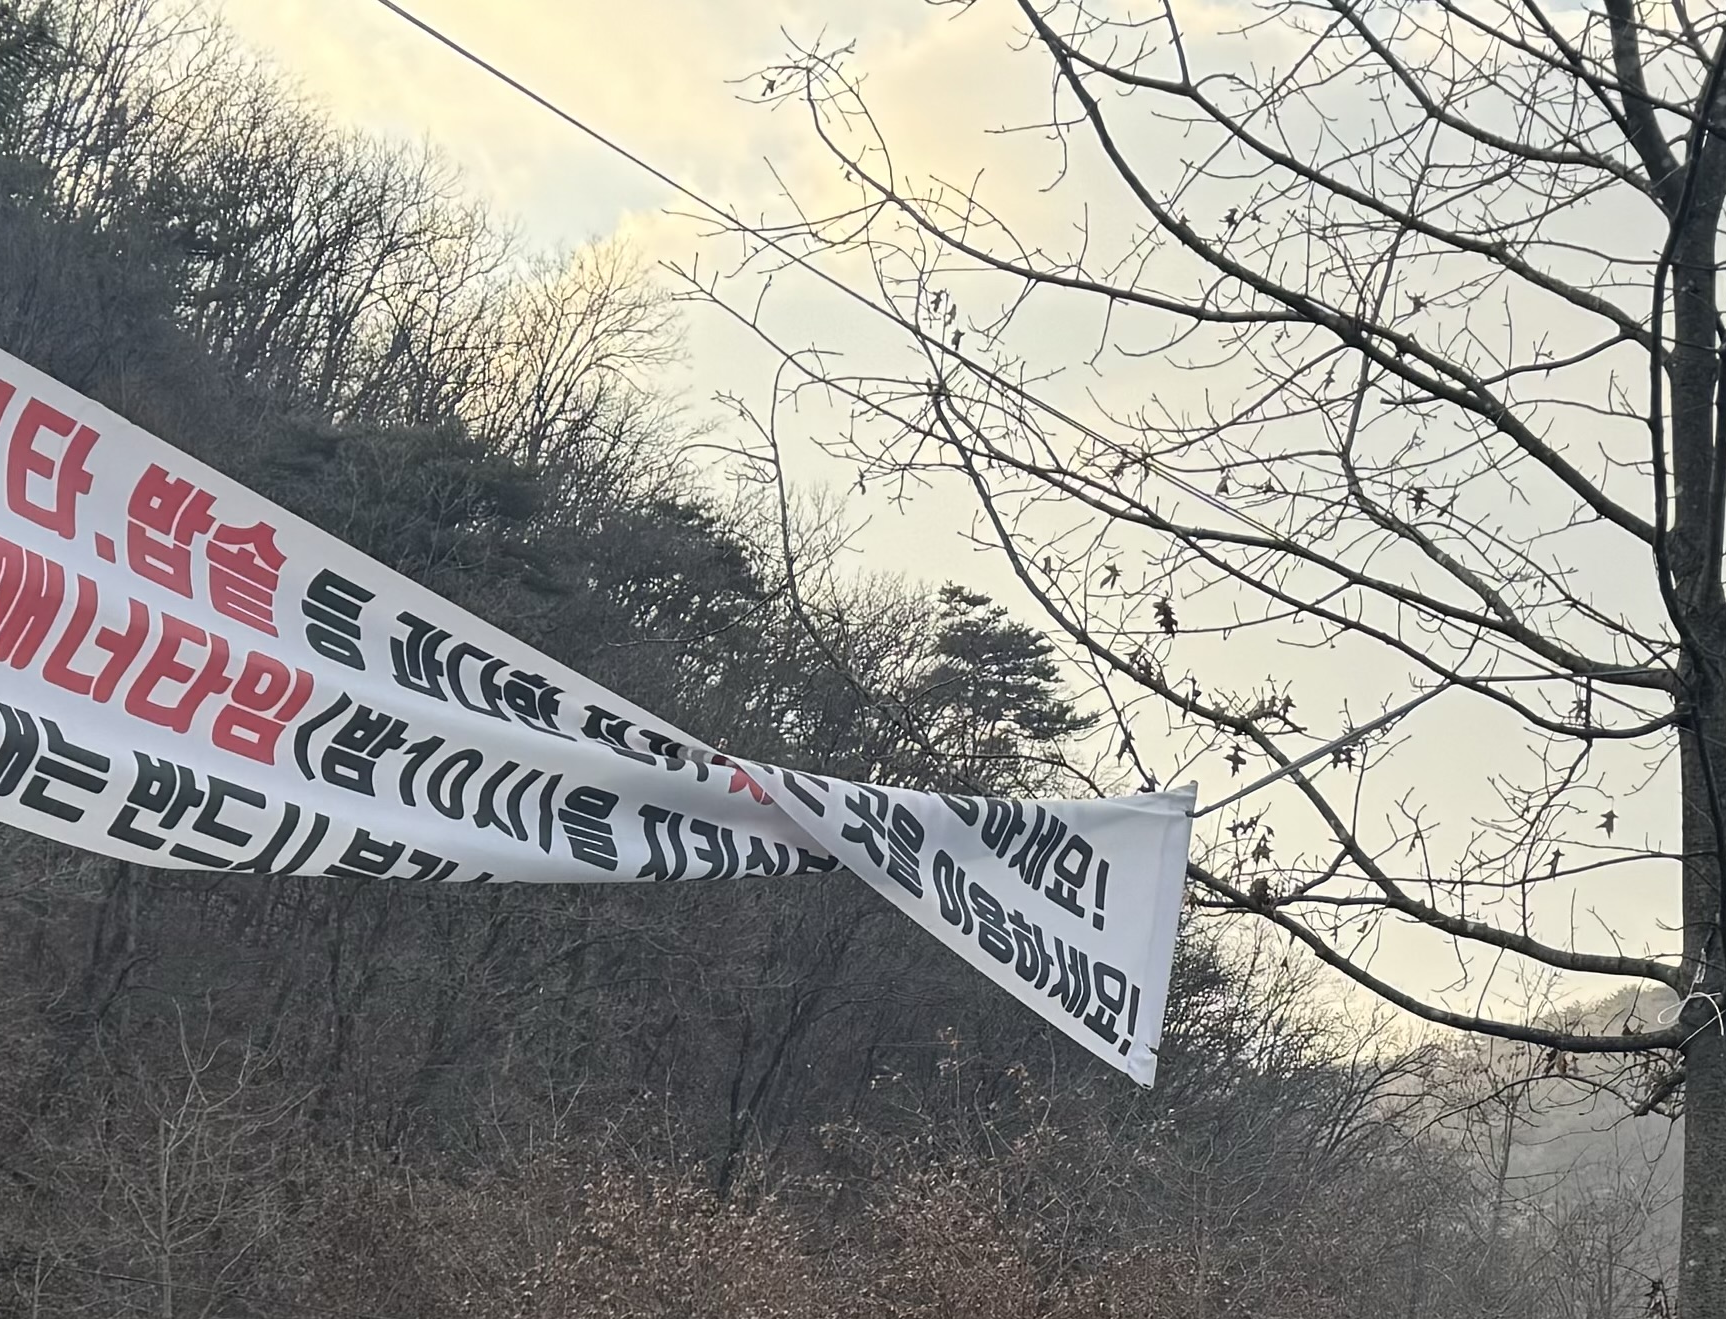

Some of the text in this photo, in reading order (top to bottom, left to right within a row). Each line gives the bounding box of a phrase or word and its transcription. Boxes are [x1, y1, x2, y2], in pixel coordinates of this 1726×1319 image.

[301, 568, 376, 671] 등
[389, 611, 578, 742] 과다한
[933, 849, 1141, 1056] 이용하세요!
